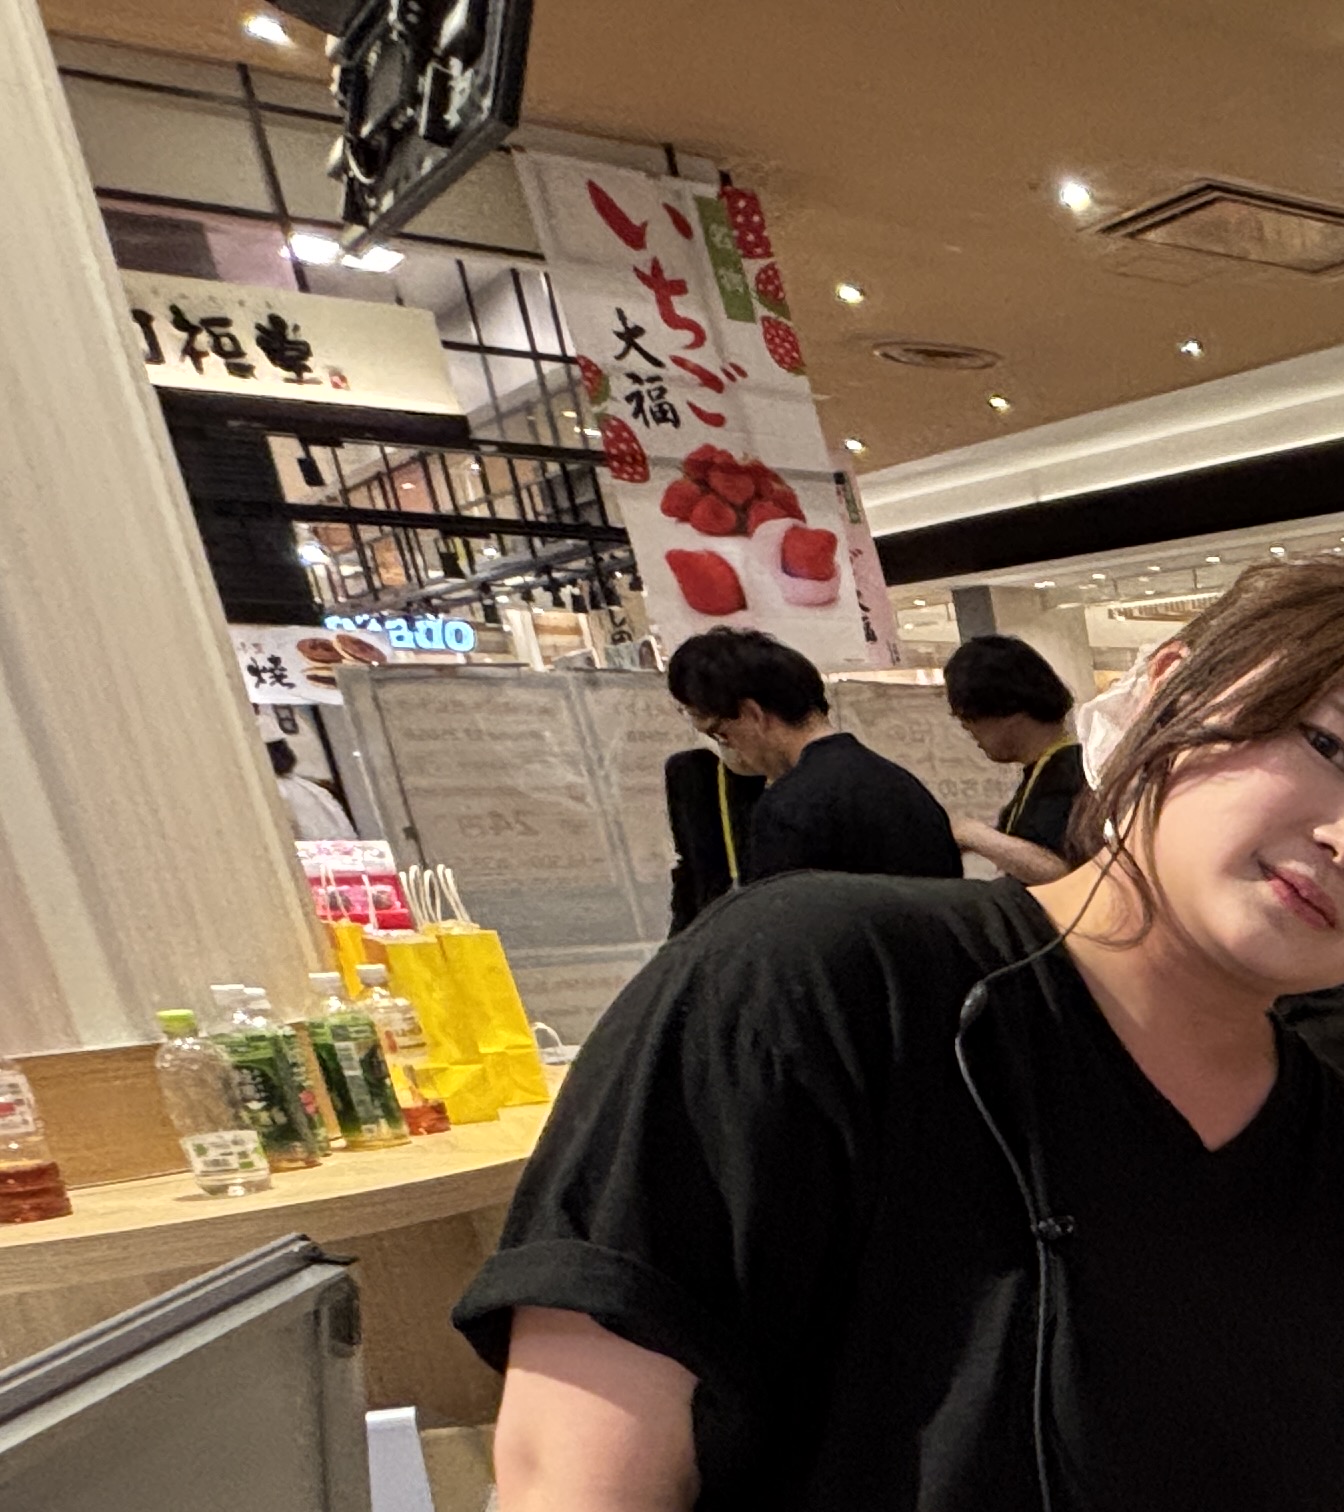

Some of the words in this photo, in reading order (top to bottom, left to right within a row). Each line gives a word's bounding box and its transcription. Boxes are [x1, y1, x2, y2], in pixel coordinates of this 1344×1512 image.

[586, 179, 748, 428] いちご
[612, 306, 681, 429] 大福
